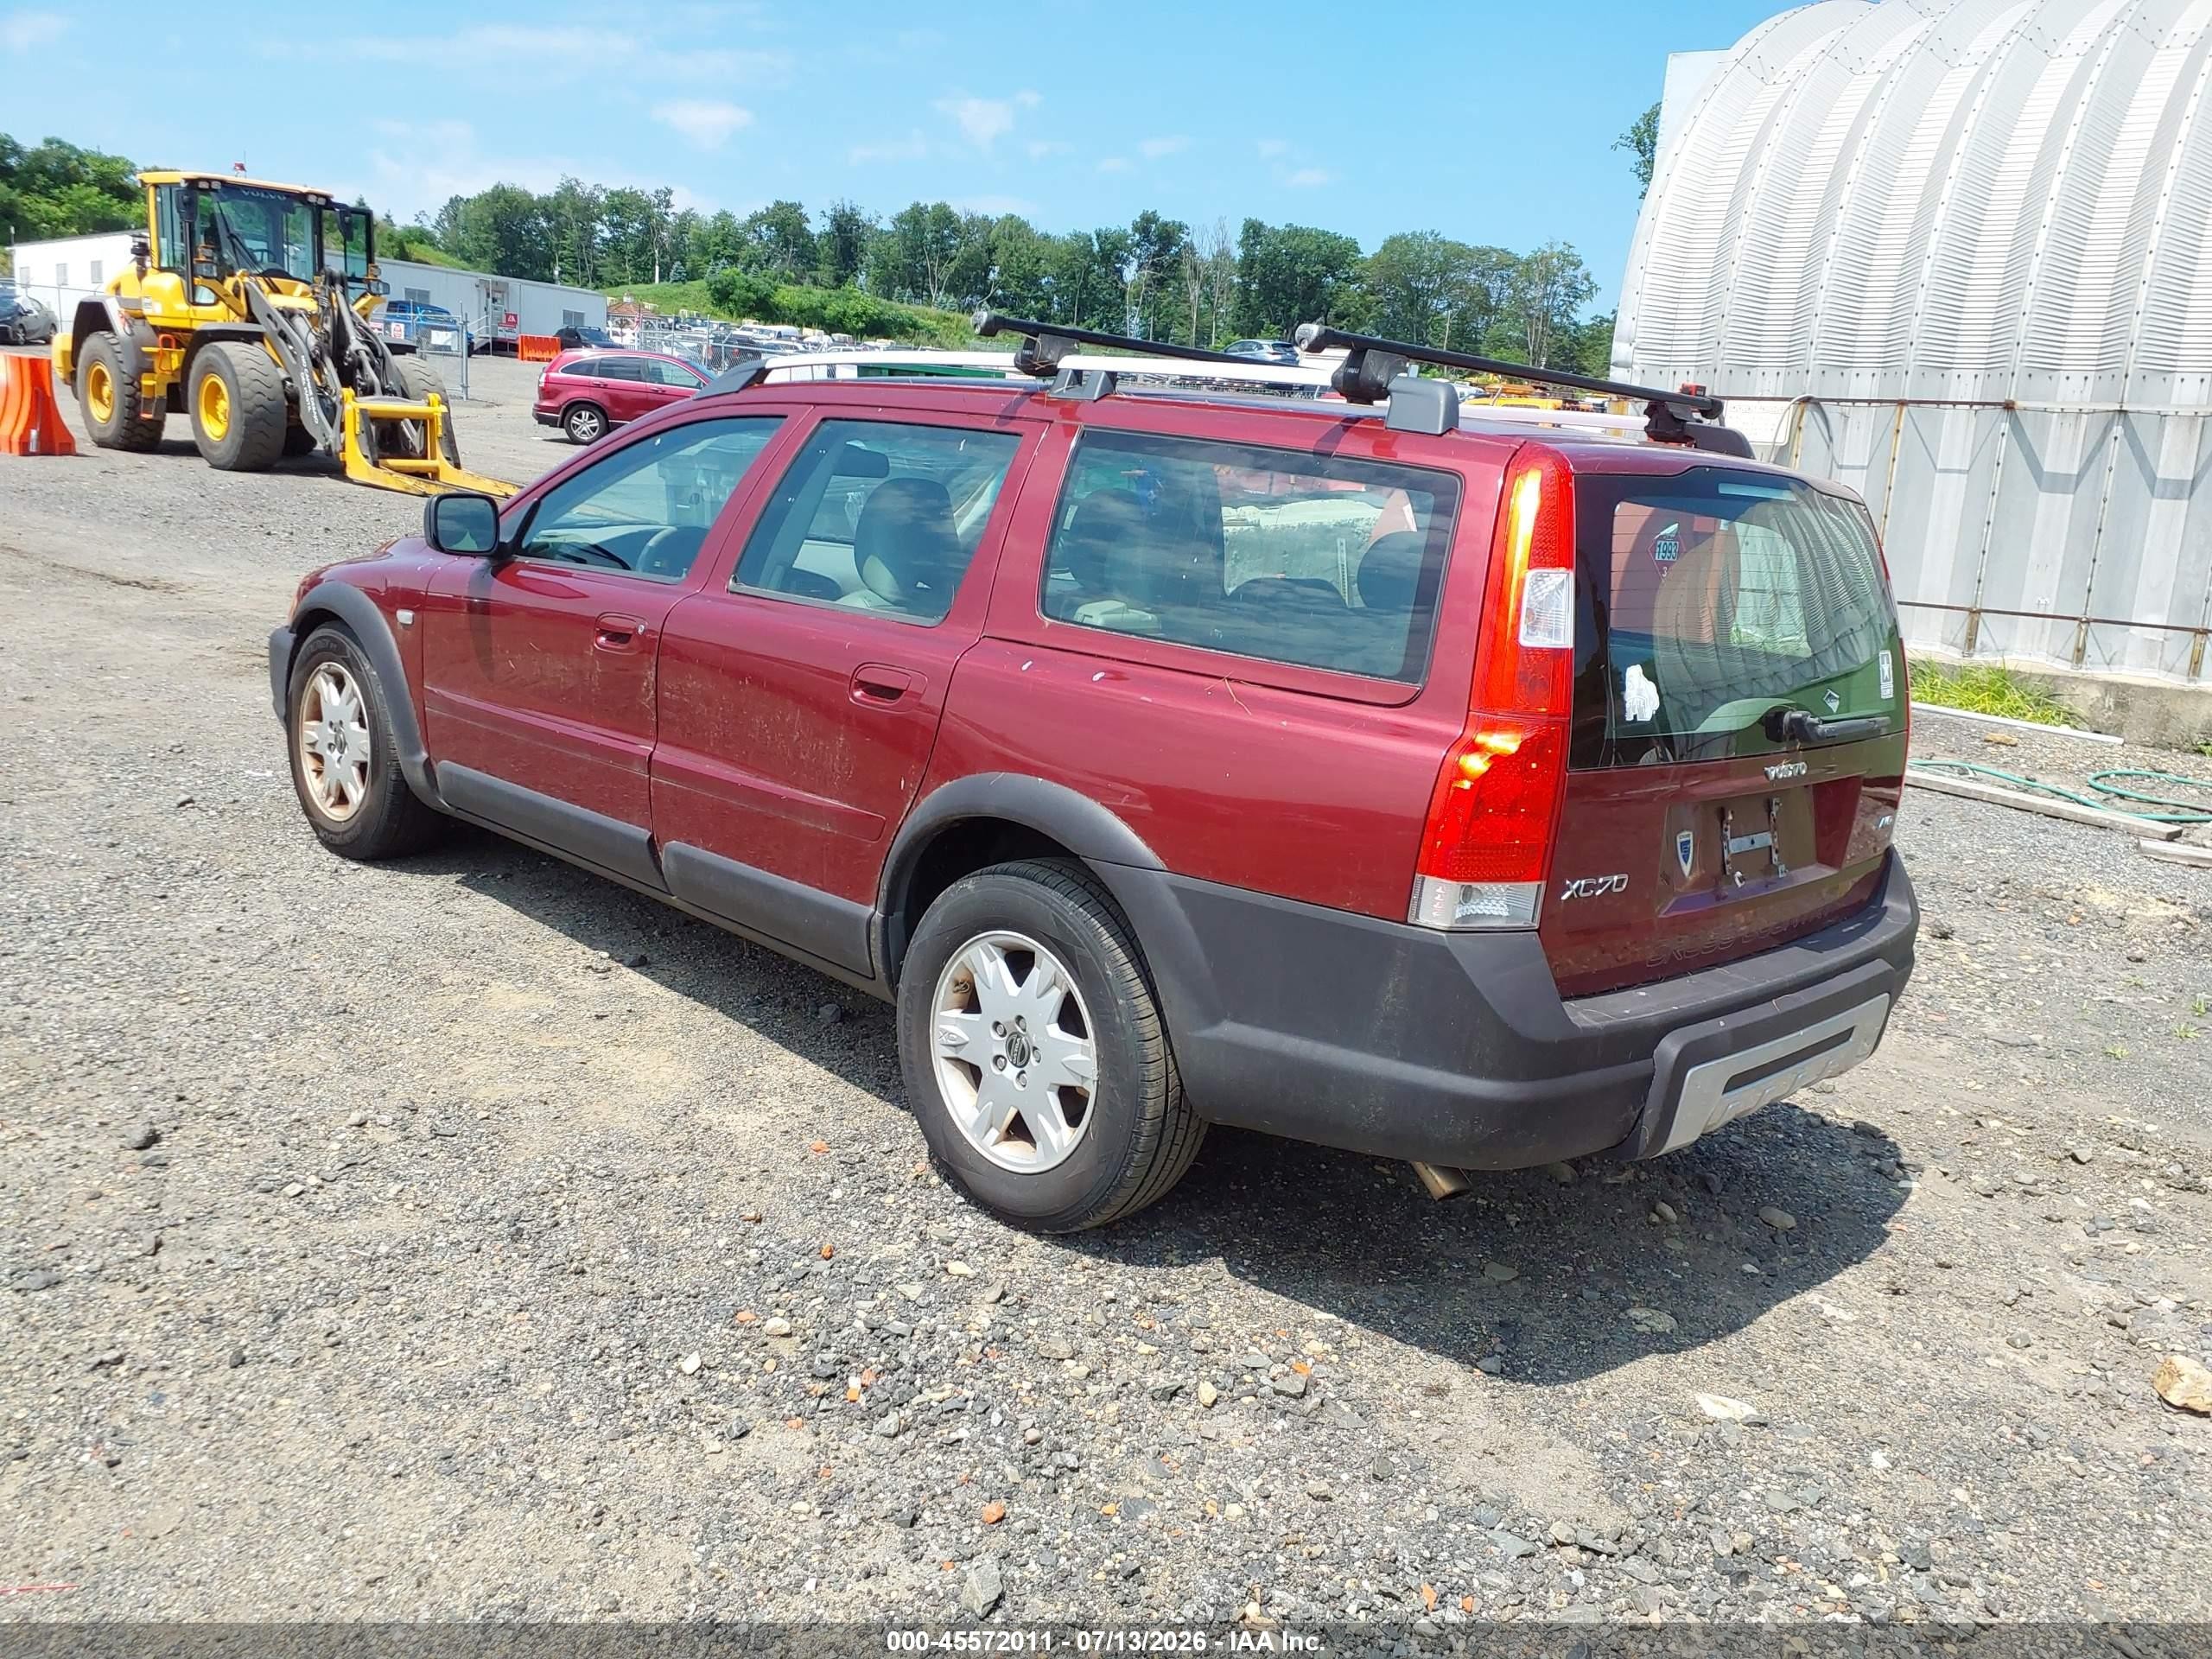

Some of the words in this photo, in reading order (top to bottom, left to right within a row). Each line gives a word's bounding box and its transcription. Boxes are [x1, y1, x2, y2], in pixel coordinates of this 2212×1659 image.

[241, 189, 287, 201] VOLVO
[1656, 541, 1678, 560] 1993
[1662, 566, 1668, 577] 3
[1560, 874, 1629, 900] XC70
